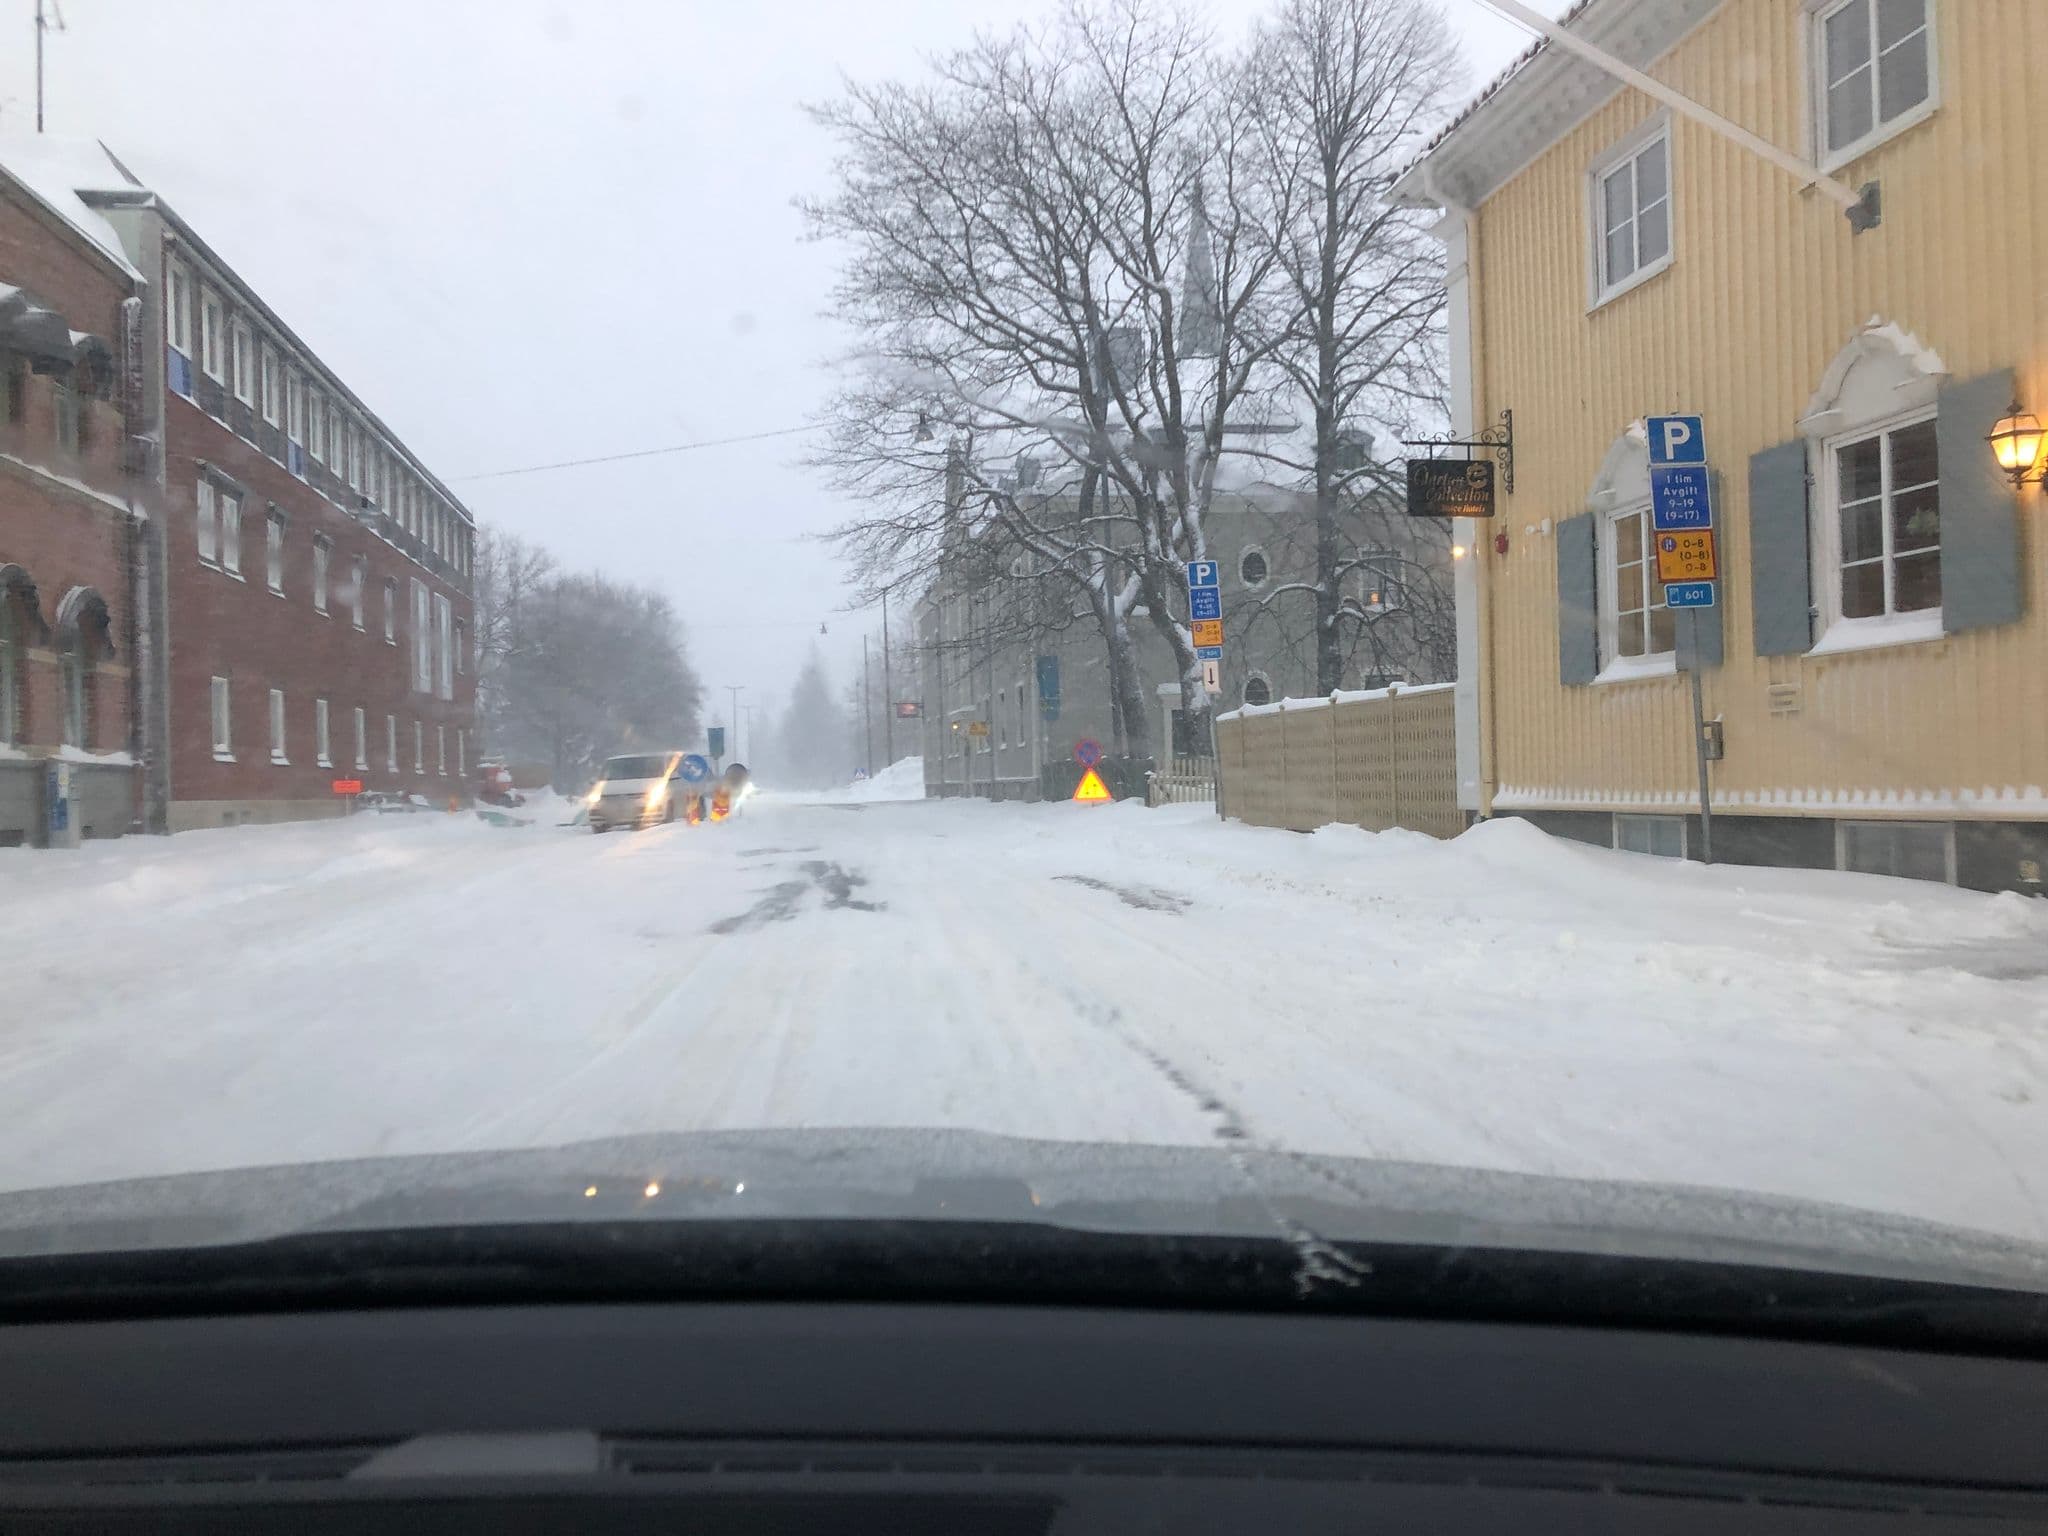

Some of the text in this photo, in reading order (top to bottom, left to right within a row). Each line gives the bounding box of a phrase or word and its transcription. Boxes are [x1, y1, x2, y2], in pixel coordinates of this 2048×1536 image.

[1663, 421, 1690, 460] P
[1675, 474, 1692, 484] tim
[1663, 487, 1698, 498] Avgift
[1668, 498, 1694, 508] 9-19
[1665, 510, 1700, 521] (9-17)
[1683, 539, 1704, 548] 0-8
[1196, 564, 1210, 585] P
[1685, 590, 1704, 600] 601
